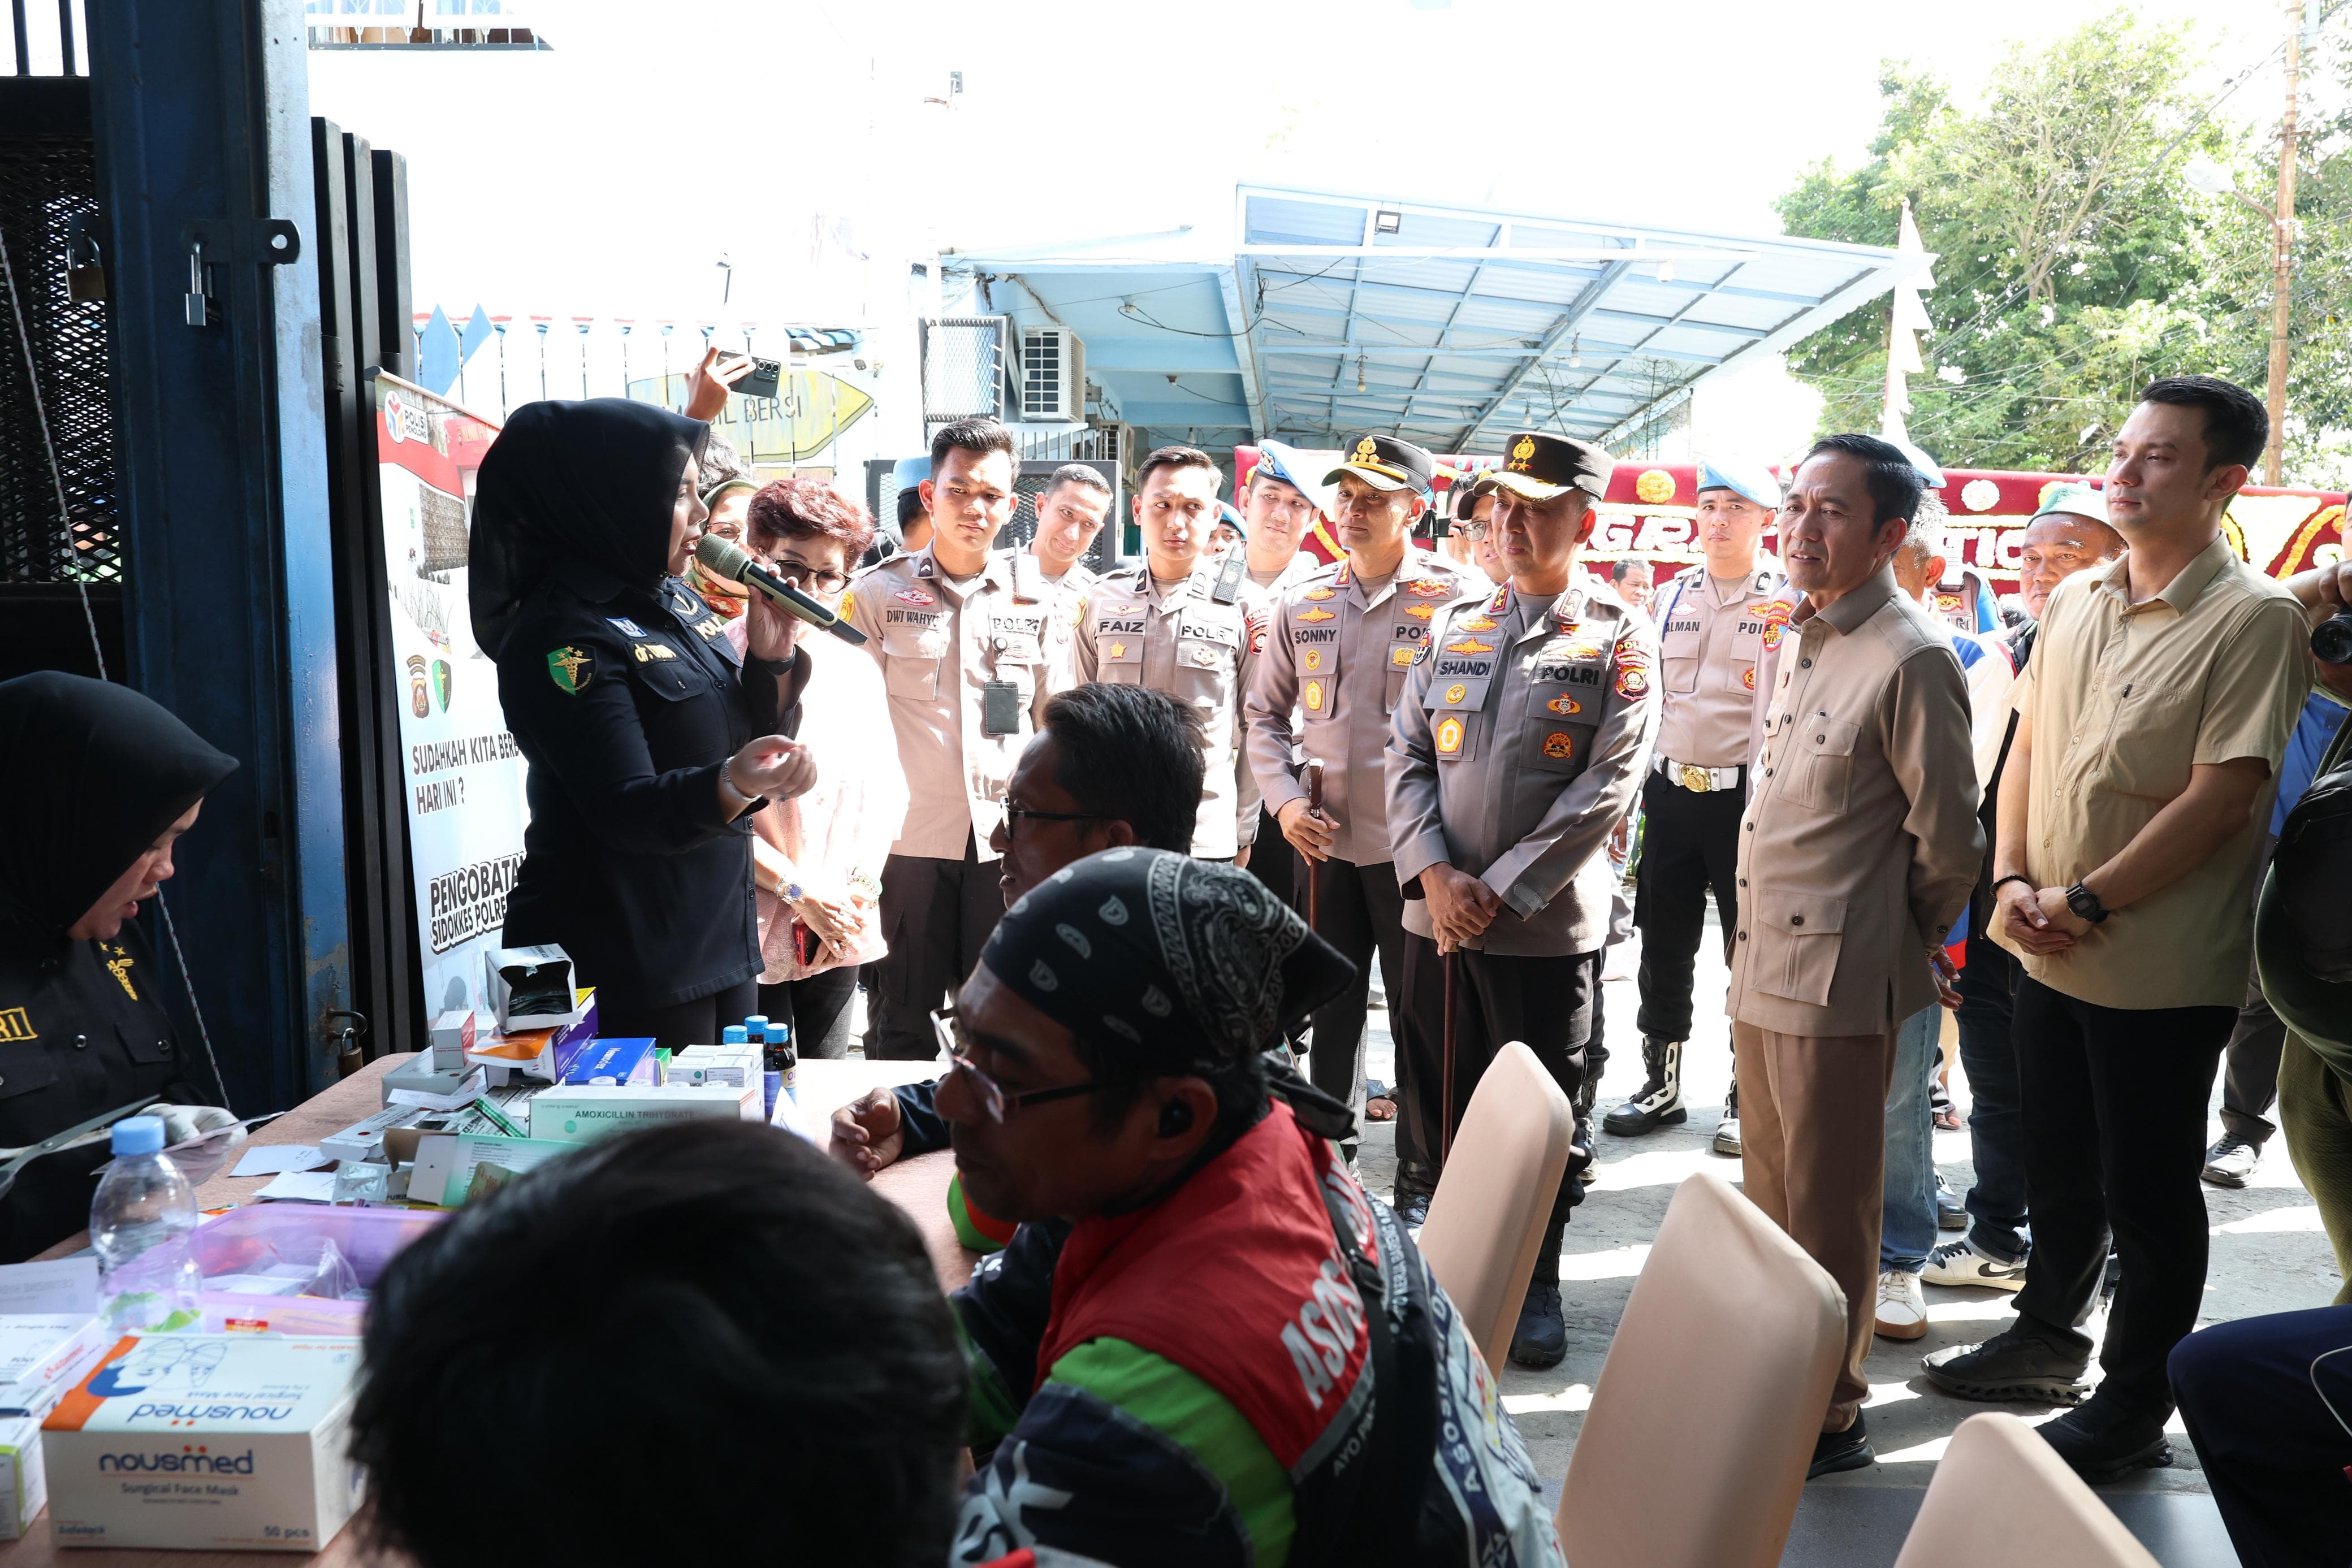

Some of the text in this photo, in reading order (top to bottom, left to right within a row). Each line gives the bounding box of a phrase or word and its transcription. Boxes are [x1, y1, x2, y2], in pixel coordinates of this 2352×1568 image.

[405, 409, 427, 430] POLISI
[405, 425, 427, 439] PENOLONG
[887, 610, 903, 623] DWI
[1099, 621, 1145, 633] FAIZ
[1295, 629, 1337, 644] SONNY
[1439, 661, 1491, 676] SHANDI
[1542, 666, 1600, 686] POLRI
[413, 739, 467, 775] SUDAHKAH
[470, 735, 497, 764] KITA
[416, 776, 464, 815] HARI INI ?
[430, 855, 524, 917] PENGOBATA
[432, 907, 473, 946] SIDOKKES
[575, 1111, 697, 1120] AMOXICILLIN TRIHYDRATE
[127, 1403, 292, 1427] nousmed
[100, 1445, 254, 1475] nousmed
[121, 1482, 240, 1498] Surgical Face Mask
[264, 1526, 310, 1540] 50 pcs
